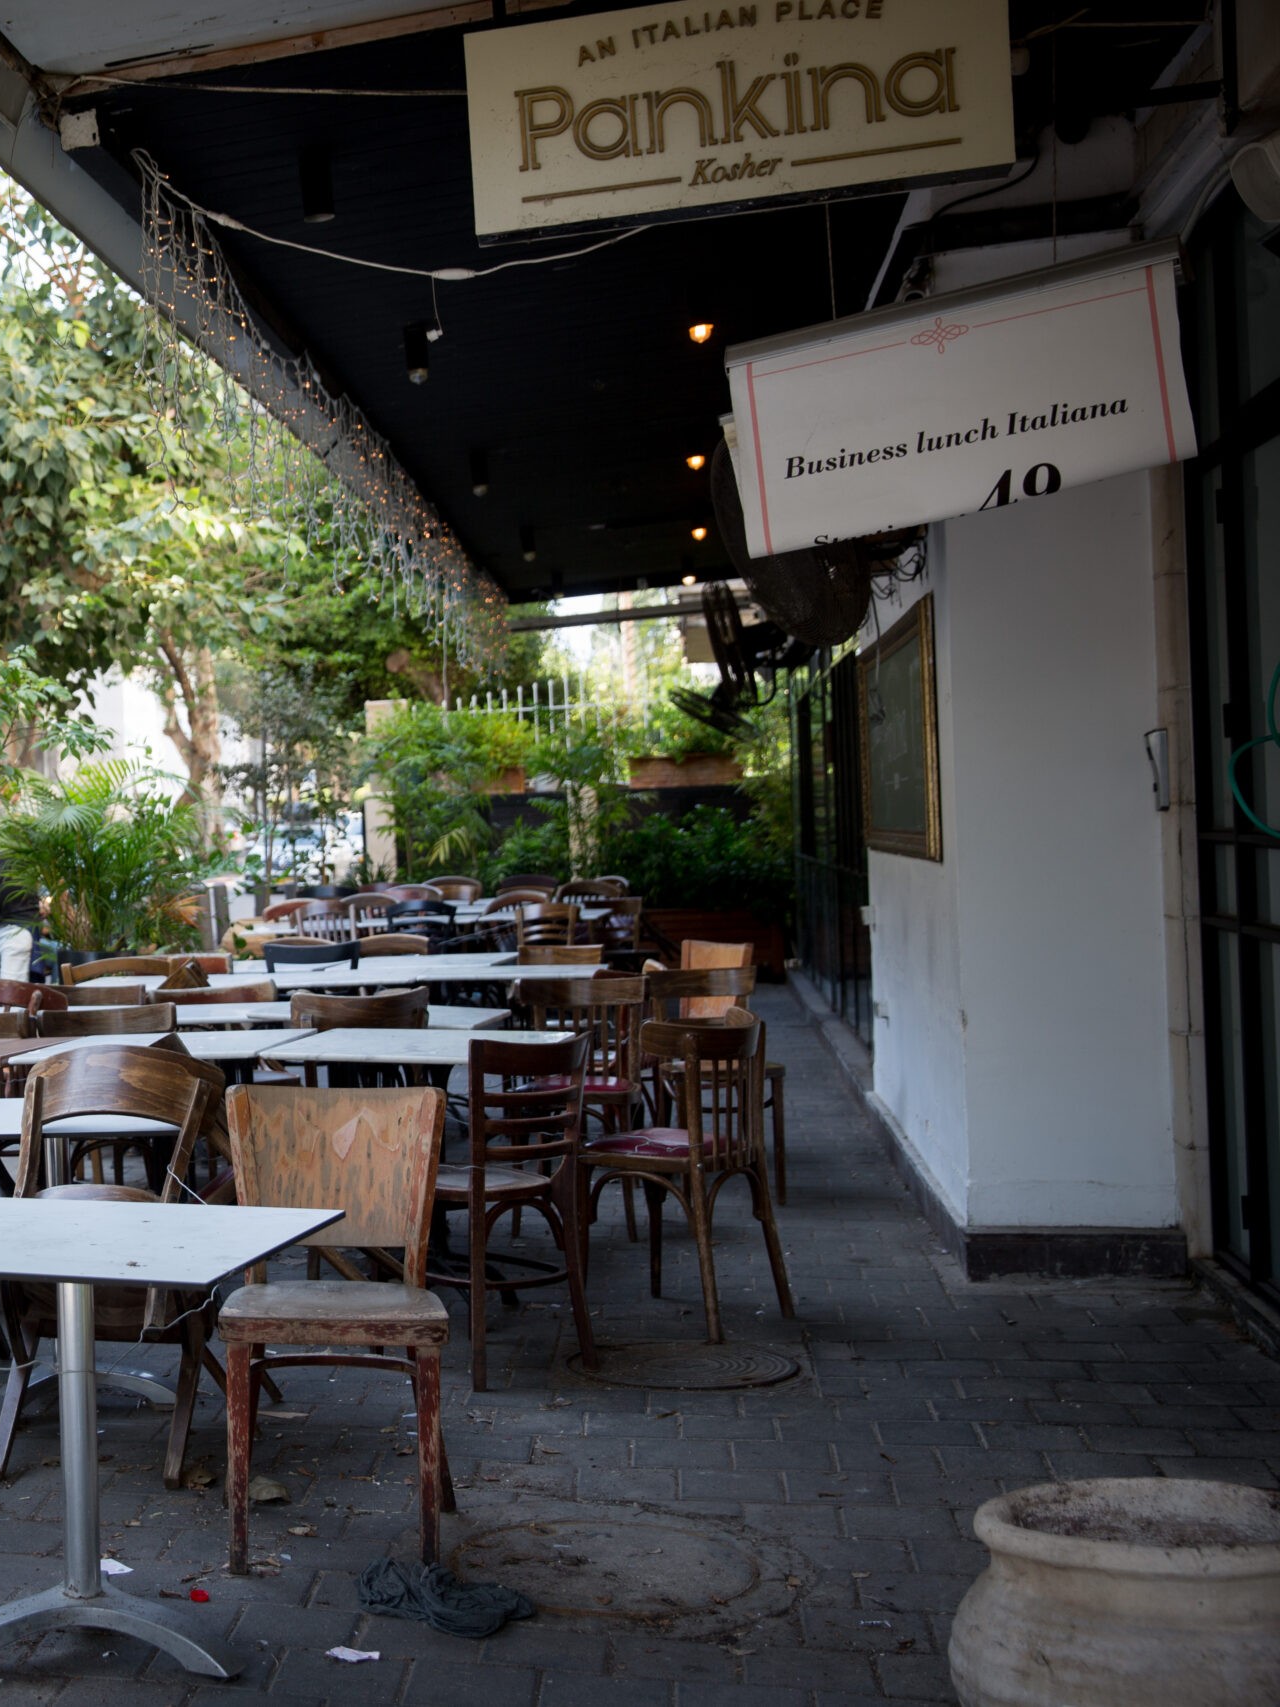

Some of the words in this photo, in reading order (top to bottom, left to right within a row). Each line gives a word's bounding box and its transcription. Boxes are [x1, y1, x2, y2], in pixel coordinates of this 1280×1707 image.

[578, 36, 617, 67] AN
[632, 5, 757, 49] ITALIAN
[776, 0, 883, 22] PLACE
[514, 47, 960, 172] Pankina
[688, 153, 783, 187] Kosher
[784, 442, 908, 479] Business
[916, 418, 999, 454] lunch
[1006, 399, 1129, 436] Italiana
